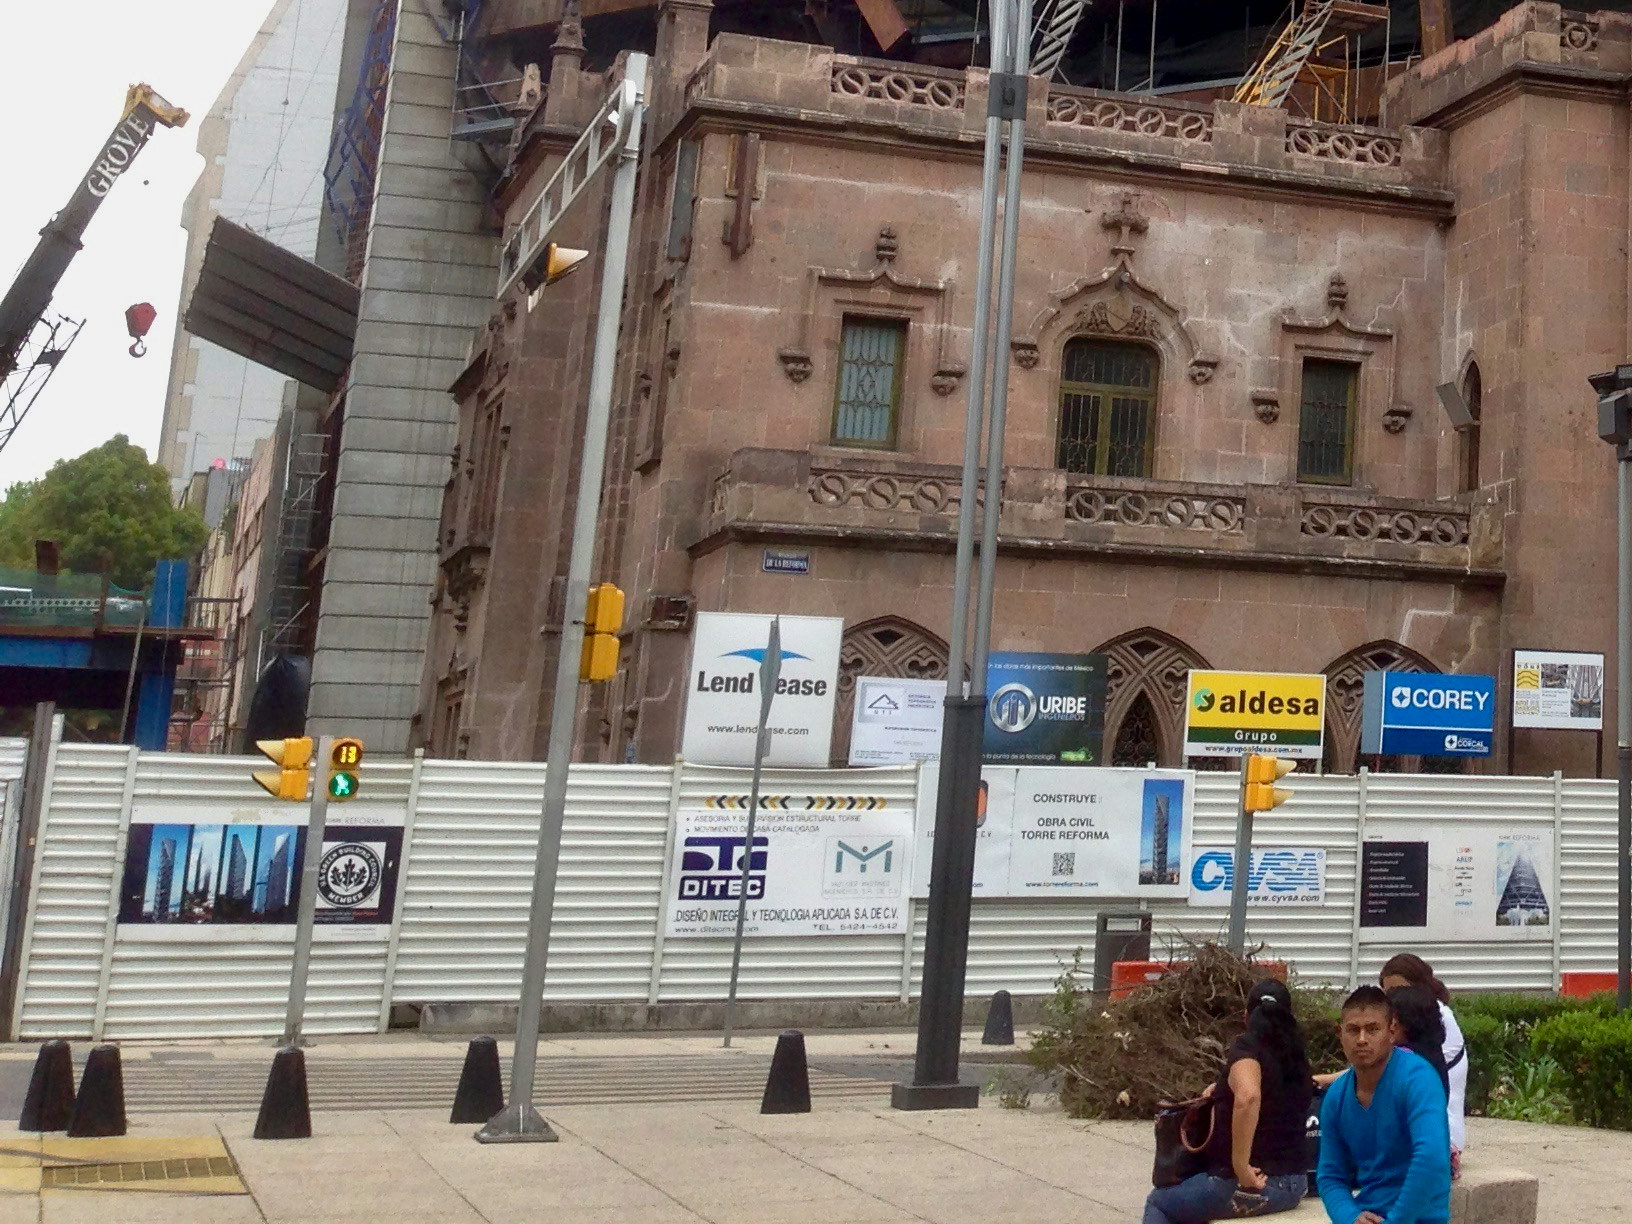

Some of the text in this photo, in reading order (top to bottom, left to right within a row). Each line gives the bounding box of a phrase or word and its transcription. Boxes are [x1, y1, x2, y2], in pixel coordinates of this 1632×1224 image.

[87, 112, 149, 198] GROVE
[697, 670, 828, 697] Lend ease
[1039, 695, 1087, 714] URIBE
[1219, 689, 1319, 716] aldesa
[1412, 688, 1490, 711] COREY
[1234, 729, 1277, 743] Grupo
[340, 746, 357, 763] 13
[1205, 745, 1303, 754] www.grupoaldesa.com.mx
[1037, 817, 1095, 827] OBRA CIVIL
[1021, 830, 1110, 840] TORRE REFORMA
[320, 853, 338, 873] GREEN
[338, 847, 371, 859] BUILDING
[368, 858, 378, 887] COUNCIL
[683, 878, 762, 898] DITEC
[328, 892, 363, 903] MEMBER
[676, 908, 708, 922] DISEÑO
[751, 909, 758, 921] Y
[759, 908, 811, 922] TECNOLOGIA
[811, 907, 851, 920] APLICADA
[870, 907, 882, 919] DE
